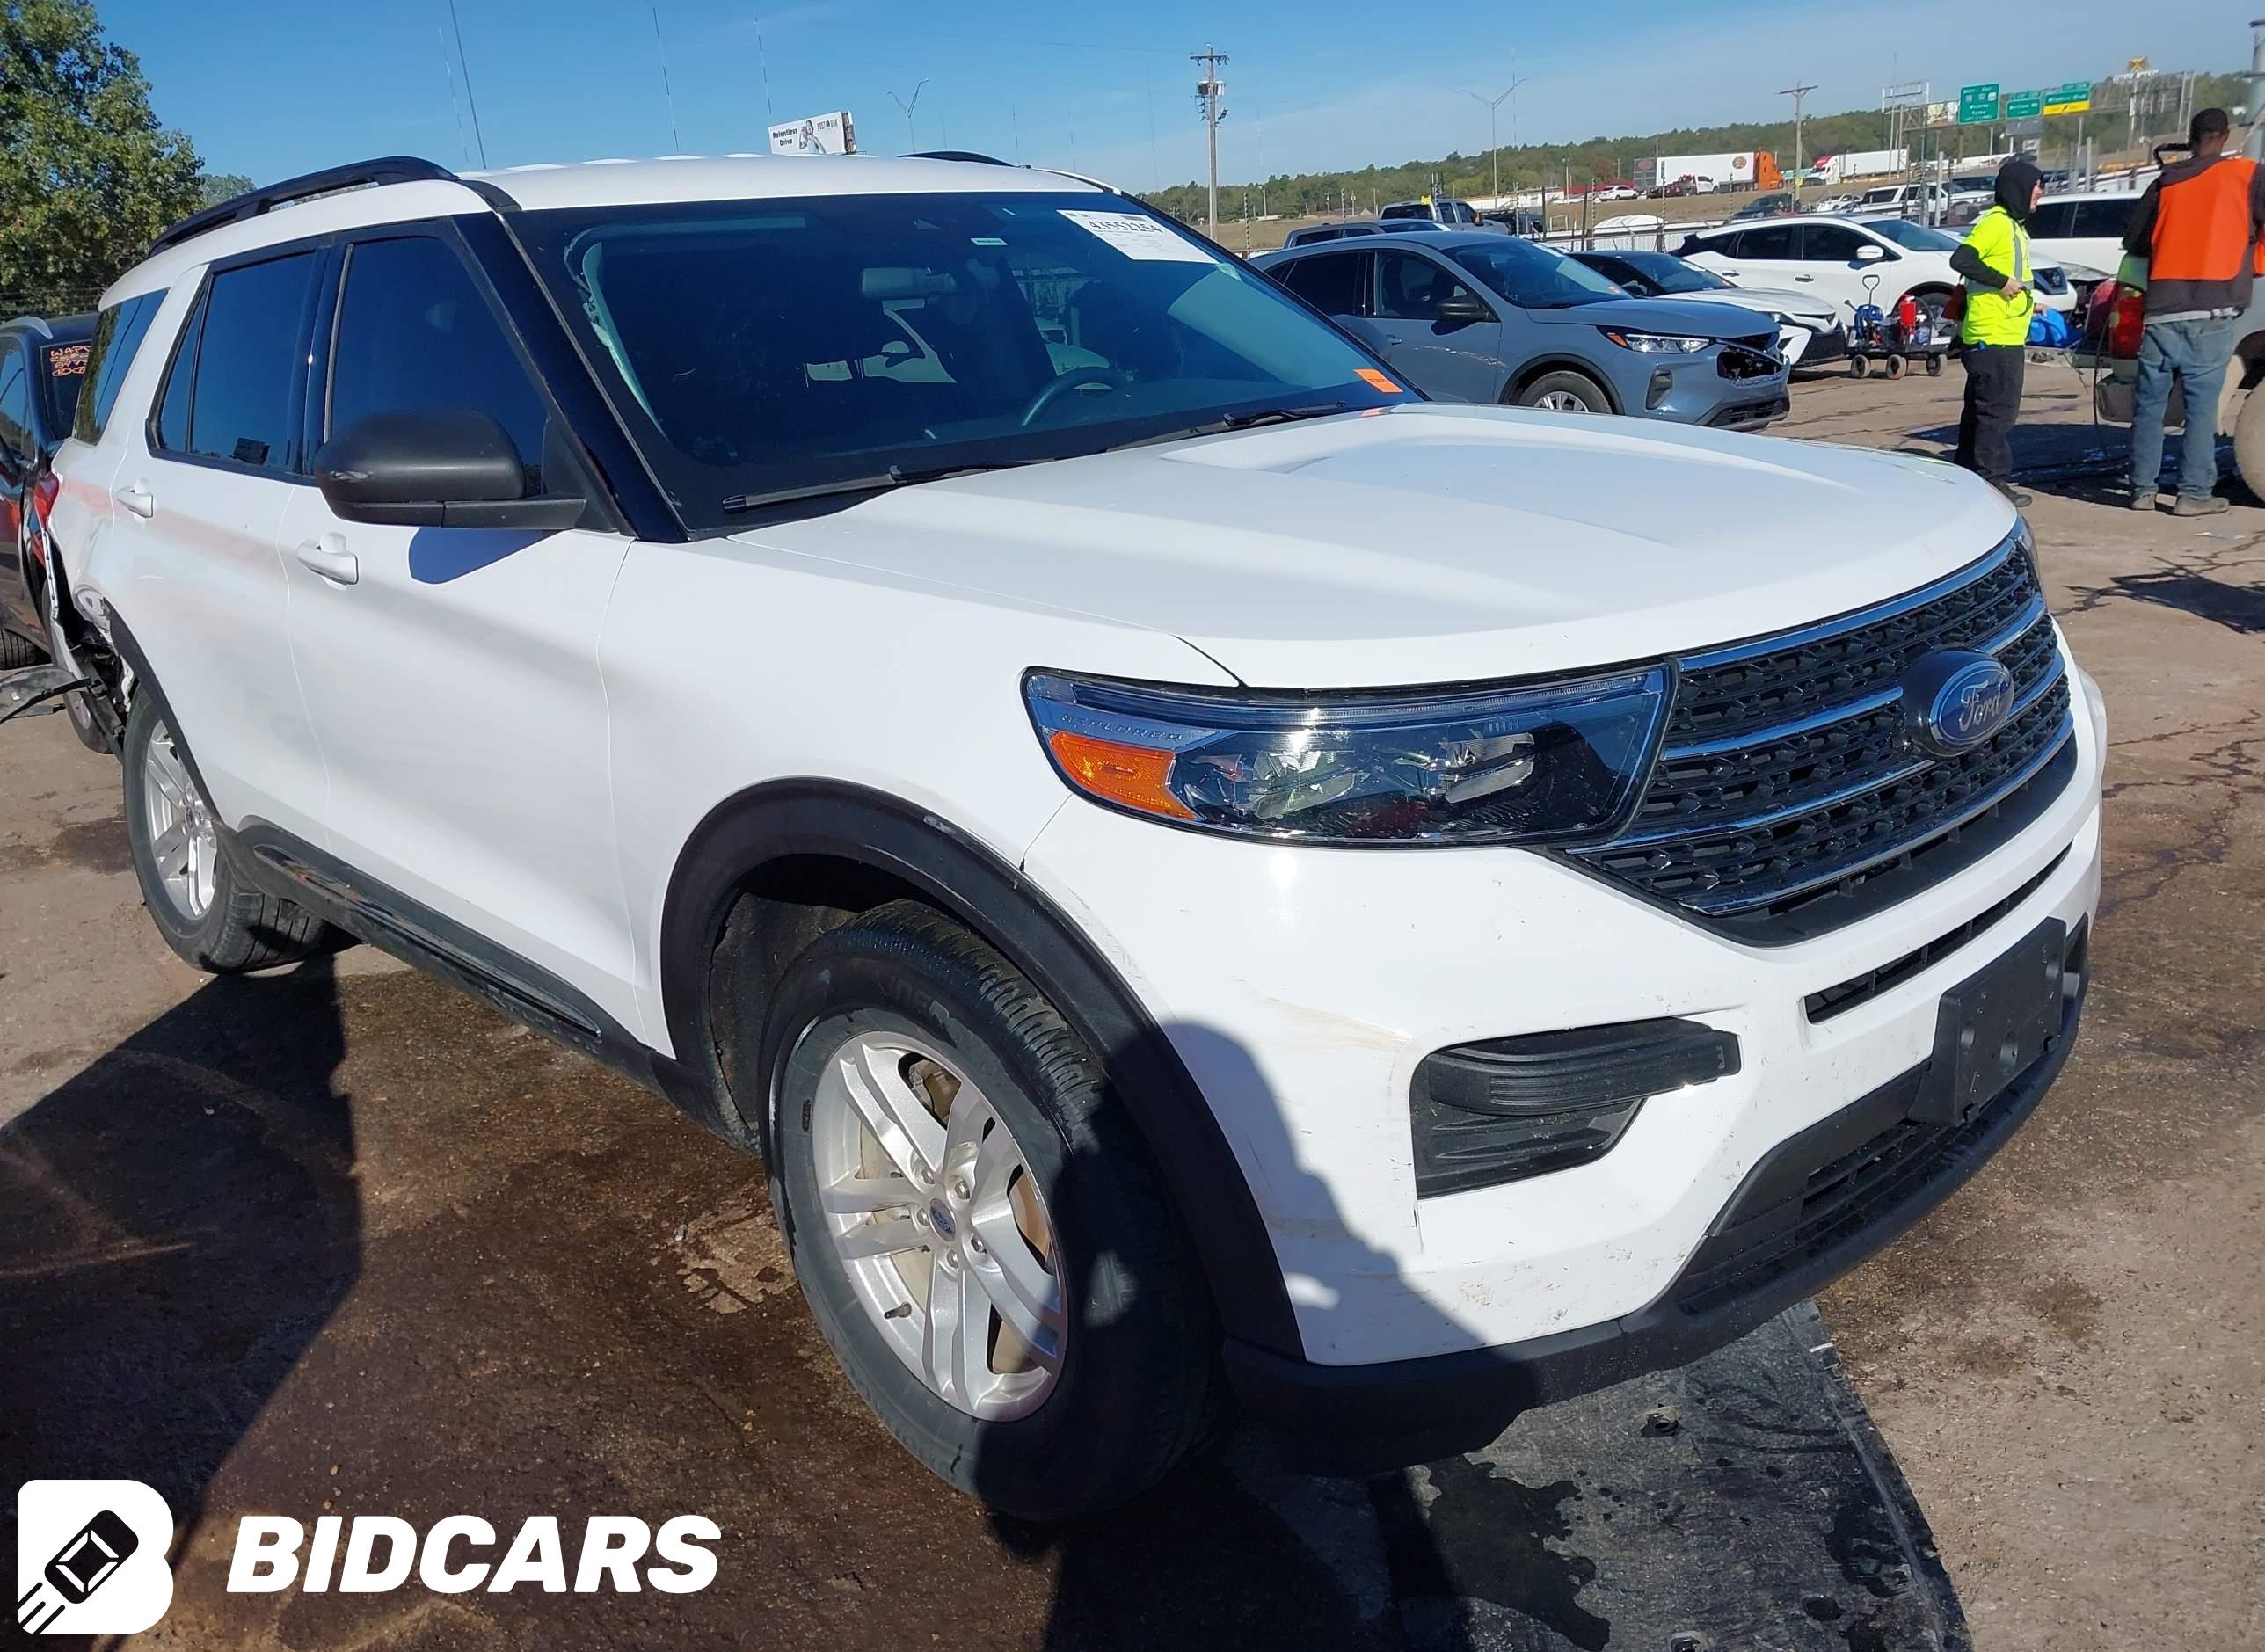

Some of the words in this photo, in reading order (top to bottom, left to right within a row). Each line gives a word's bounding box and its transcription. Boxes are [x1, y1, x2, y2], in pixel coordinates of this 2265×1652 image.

[773, 128, 797, 139] Relentless
[1088, 220, 1163, 233] 43552254
[1958, 679, 2003, 732] Ford
